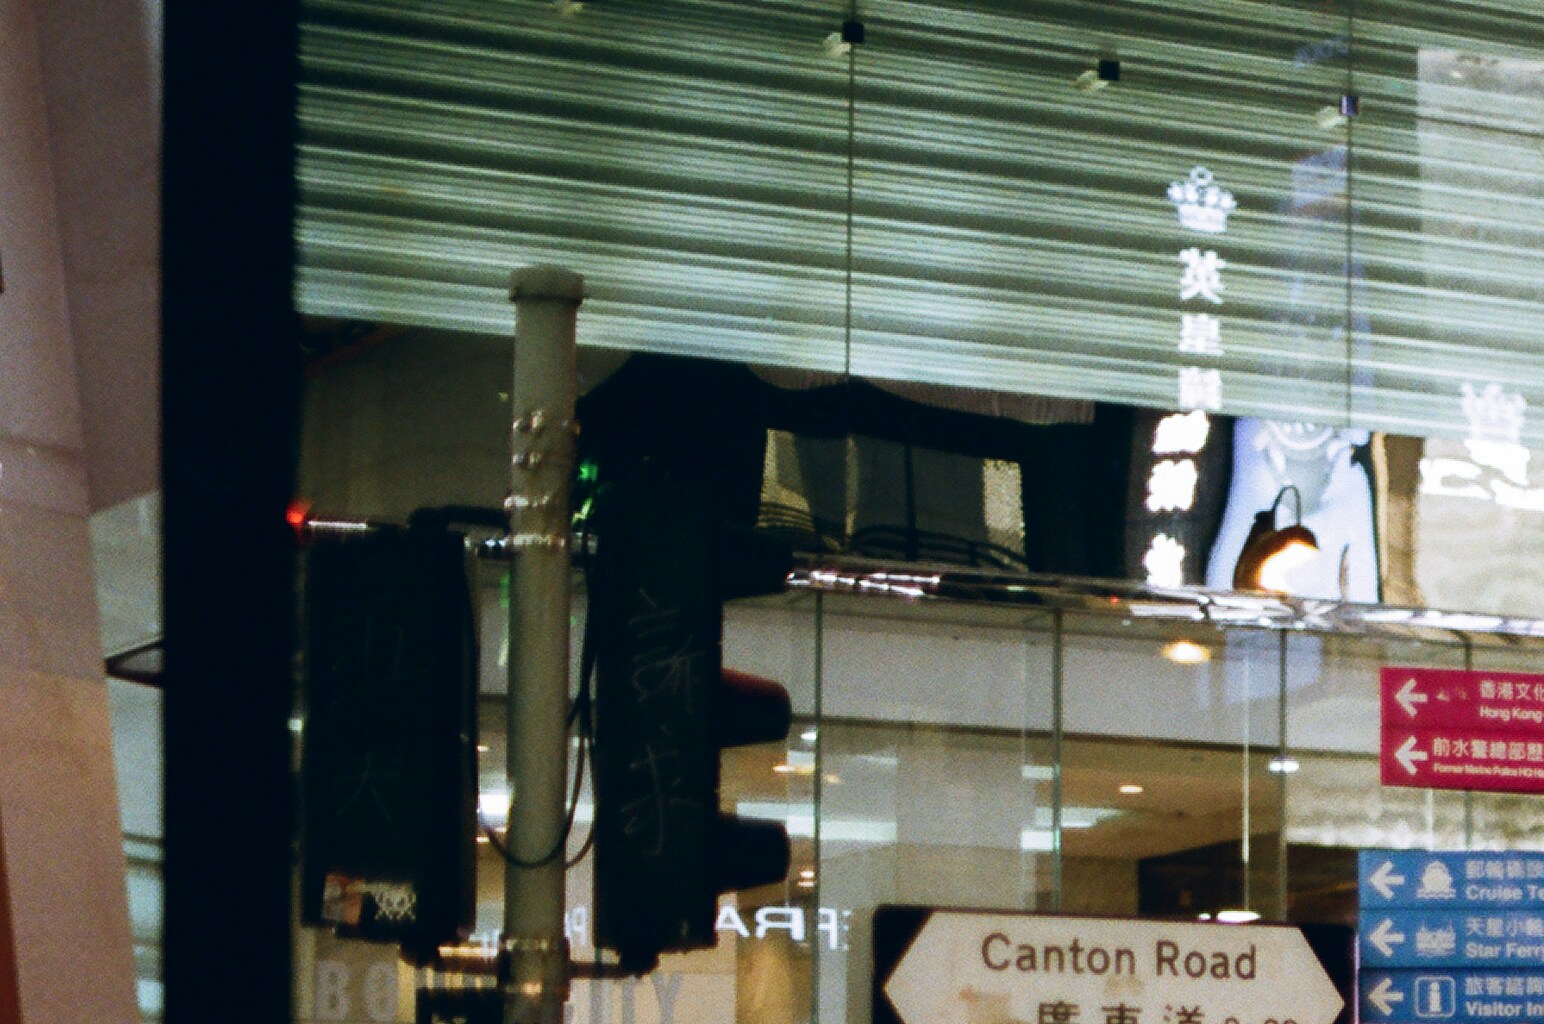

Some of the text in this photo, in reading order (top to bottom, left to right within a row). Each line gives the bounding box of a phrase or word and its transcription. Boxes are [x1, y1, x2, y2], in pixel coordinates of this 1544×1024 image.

[1480, 706, 1511, 721] Hong
[1512, 707, 1542, 723] Kong
[1466, 885, 1523, 901] Cruise
[981, 932, 1258, 981] Canton Road
[1466, 942, 1501, 959] Star
[1466, 1001, 1521, 1017] Visitor
